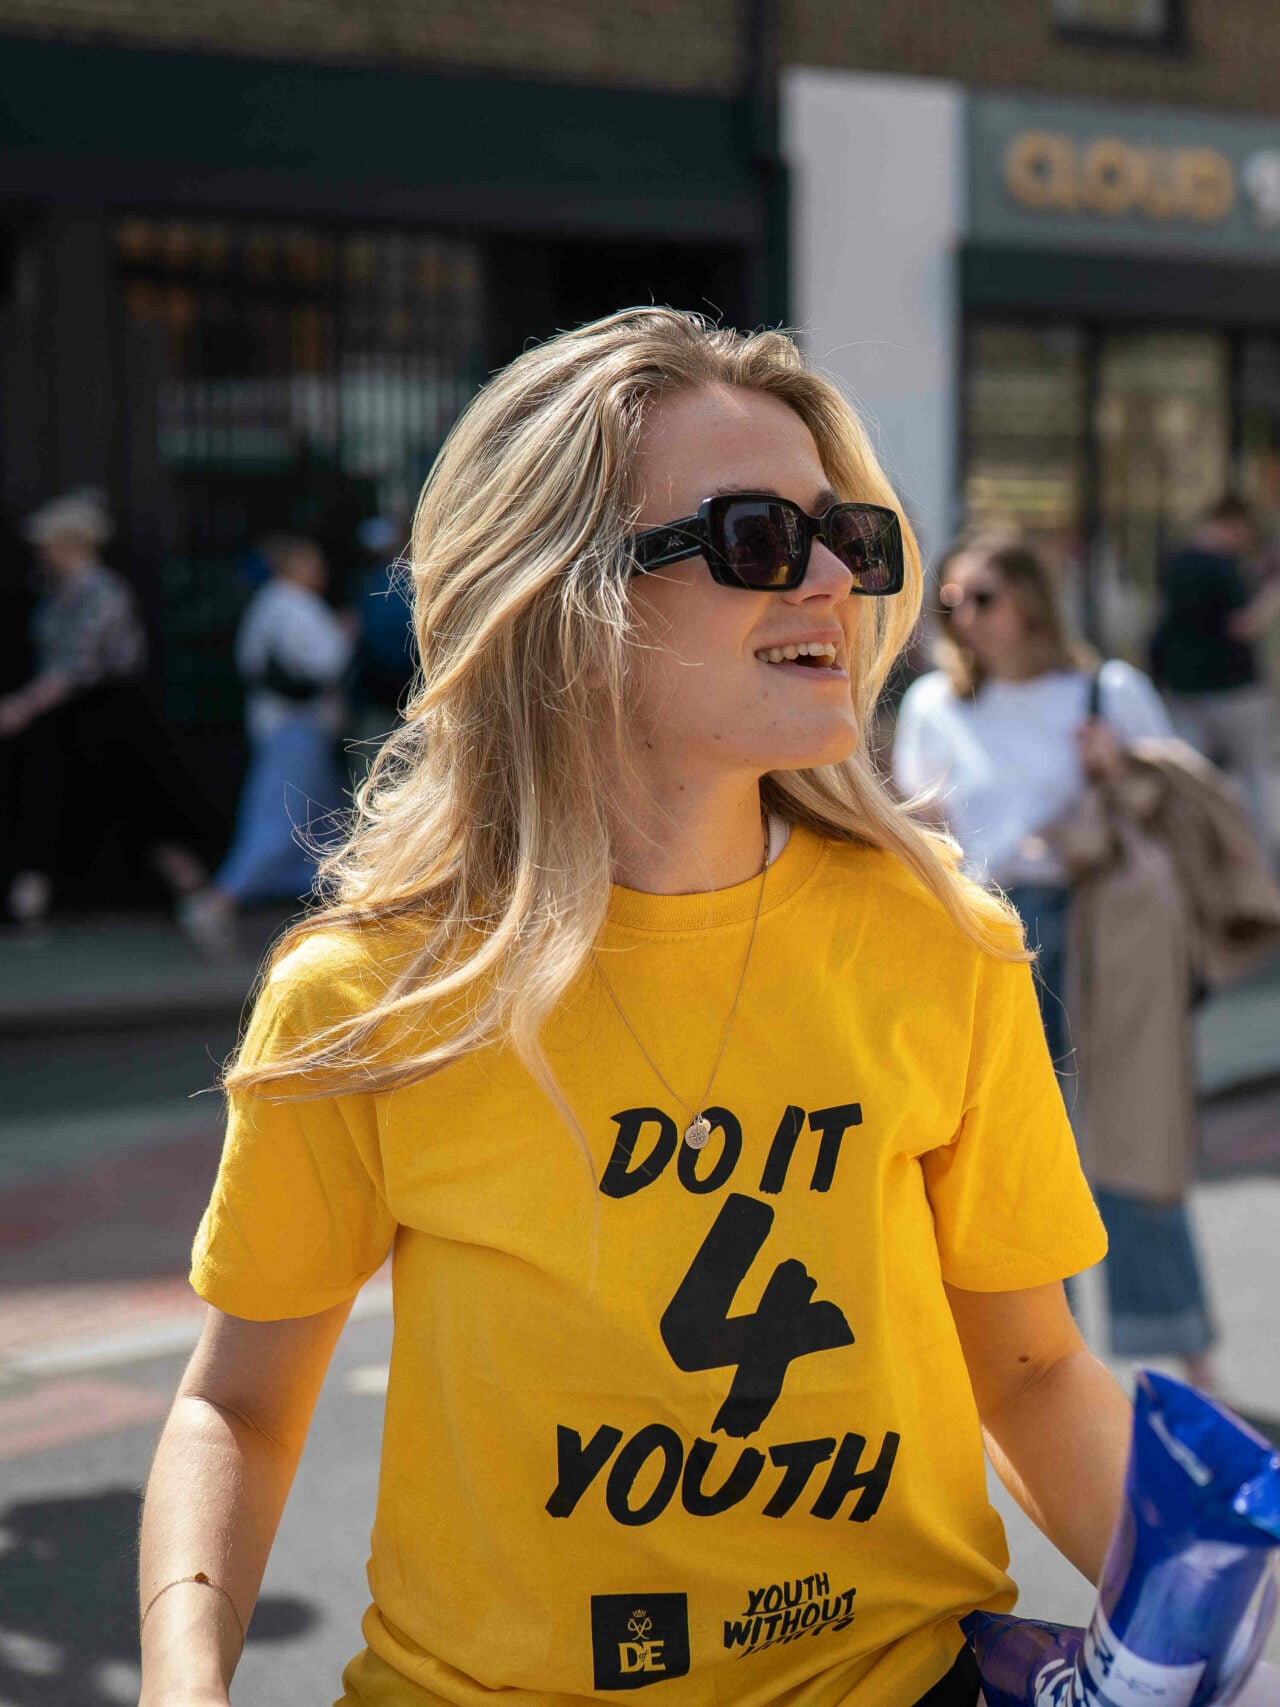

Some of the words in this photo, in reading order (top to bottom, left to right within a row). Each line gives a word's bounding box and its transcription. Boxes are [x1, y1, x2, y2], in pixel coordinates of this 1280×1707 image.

[1005, 131, 1236, 220] CLOUD
[599, 1106, 743, 1199] DO
[759, 1103, 863, 1195] IT
[660, 1193, 856, 1440] 4
[545, 1423, 901, 1527] YOUTH
[723, 1587, 857, 1650] WITHOUT
[745, 1572, 830, 1617] YOUTH
